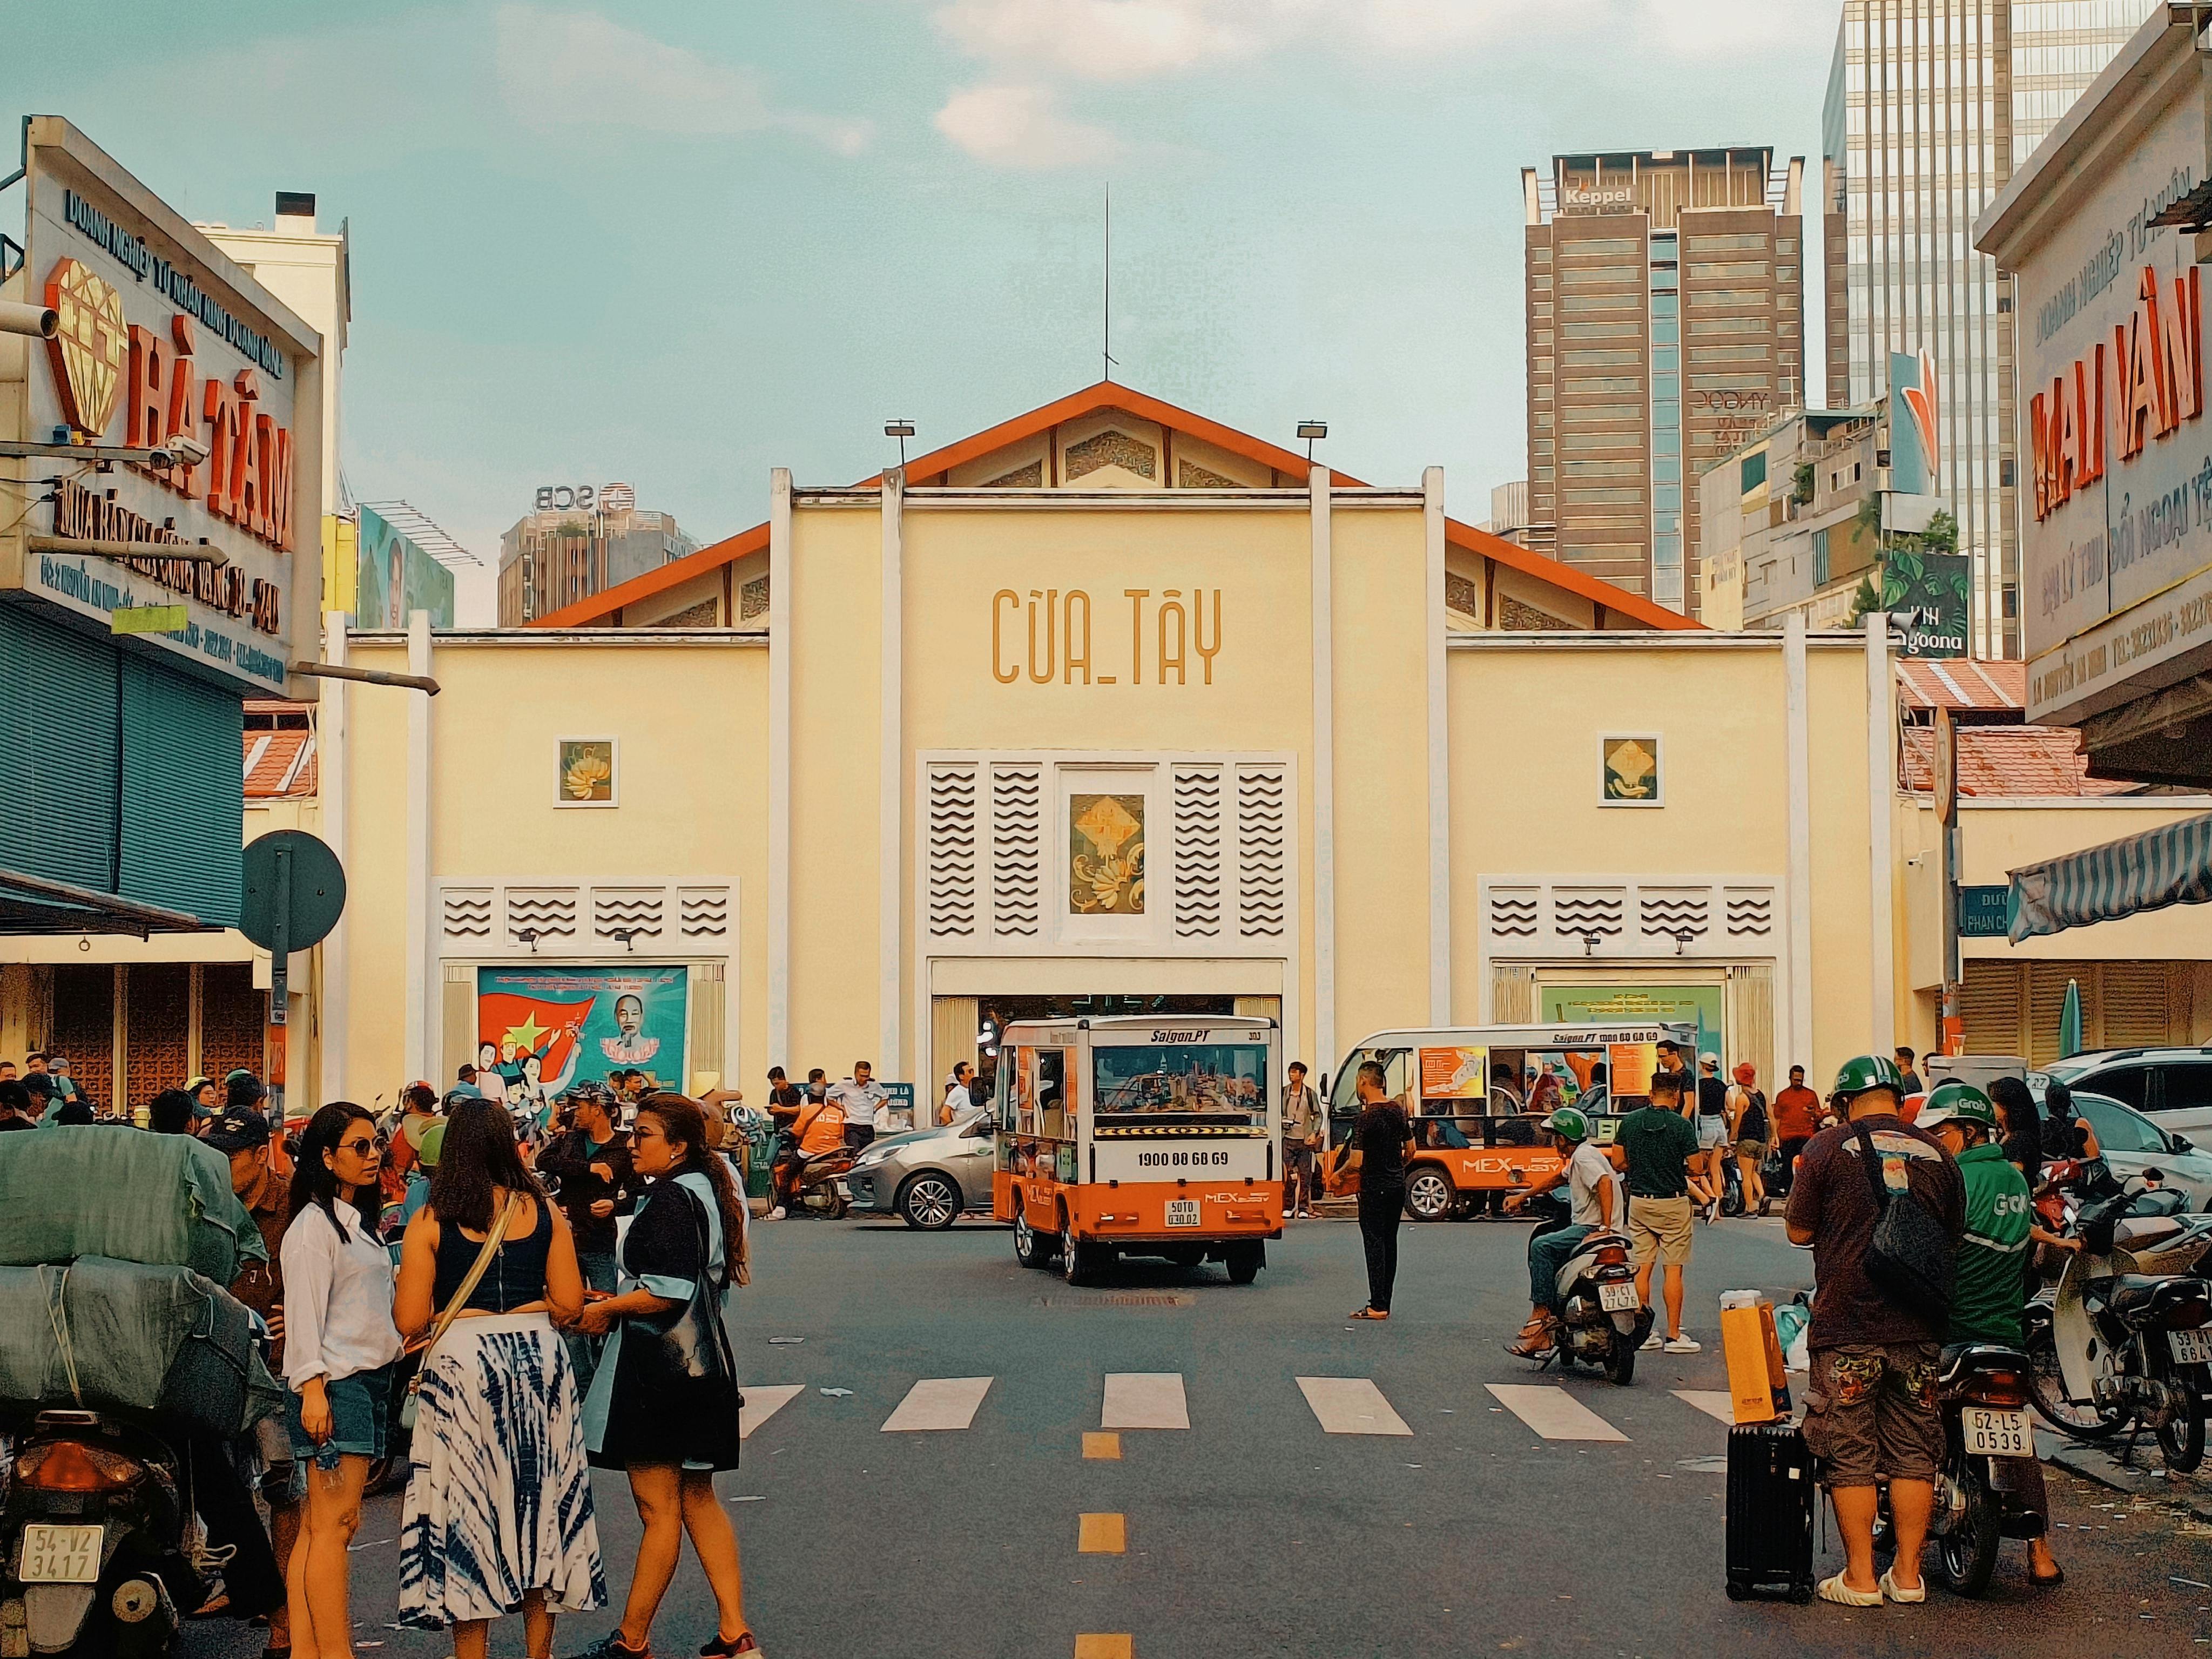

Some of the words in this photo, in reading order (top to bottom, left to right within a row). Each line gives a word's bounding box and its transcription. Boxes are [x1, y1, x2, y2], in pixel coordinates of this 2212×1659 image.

[1566, 188, 1630, 206] Keppel
[65, 189, 110, 249] DOANH
[1958, 1098, 1987, 1111] Grab
[1138, 1152, 1169, 1166] 1900
[1211, 1152, 1228, 1165] 69
[1463, 1157, 1512, 1173] MEX
[1977, 1432, 2021, 1451] 0539
[35, 1529, 91, 1552] 54-V2
[32, 1555, 89, 1577] 3417
